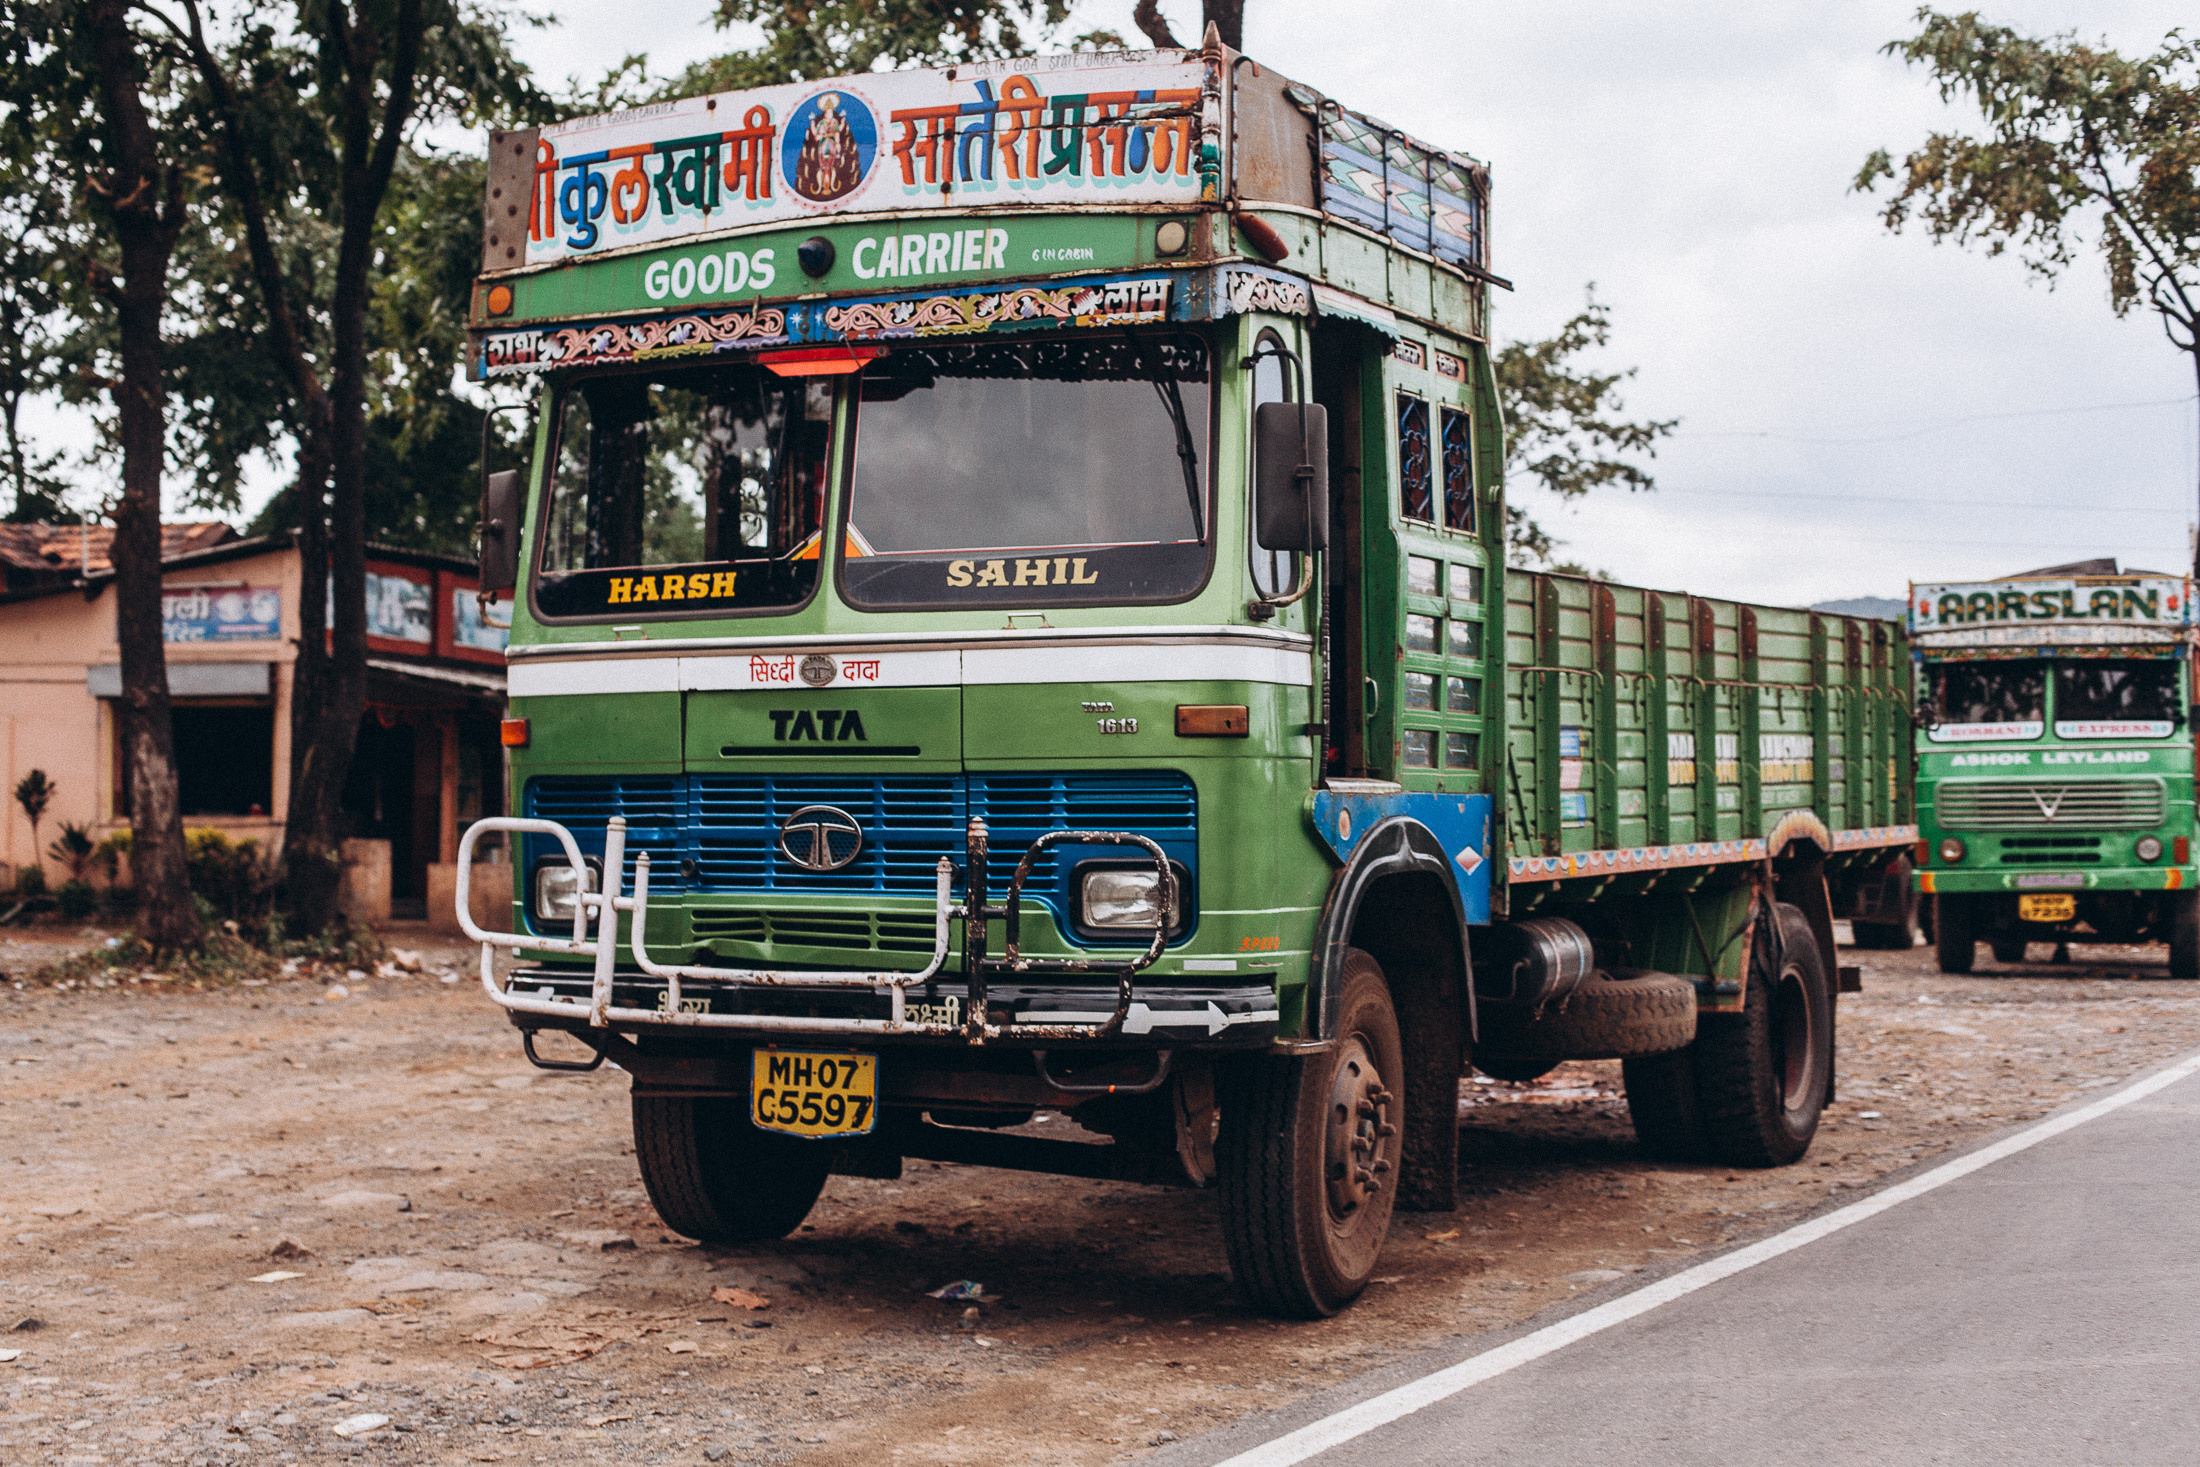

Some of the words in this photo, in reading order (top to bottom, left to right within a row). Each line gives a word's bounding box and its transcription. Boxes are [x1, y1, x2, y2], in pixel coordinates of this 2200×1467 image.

[1014, 59, 1039, 72] GOA
[645, 249, 775, 299] GOODS
[852, 228, 1009, 279] CARRIER
[1032, 249, 1040, 262] 6
[1042, 249, 1056, 261] IN
[1058, 248, 1094, 261] CABIN
[1104, 279, 1172, 313] लाभ
[487, 330, 543, 367] शुभ
[947, 558, 1099, 587] SAHIL
[607, 572, 737, 604] HARSH
[1938, 589, 2159, 624] AARSLAN
[842, 660, 880, 681] दादा
[1081, 702, 1115, 713] TATA
[769, 709, 868, 741] TATA
[1097, 718, 1138, 734] 1613
[1951, 752, 2031, 766] ASHOK
[2042, 751, 2150, 765] LEYLAND
[1238, 936, 1280, 952] SPEED
